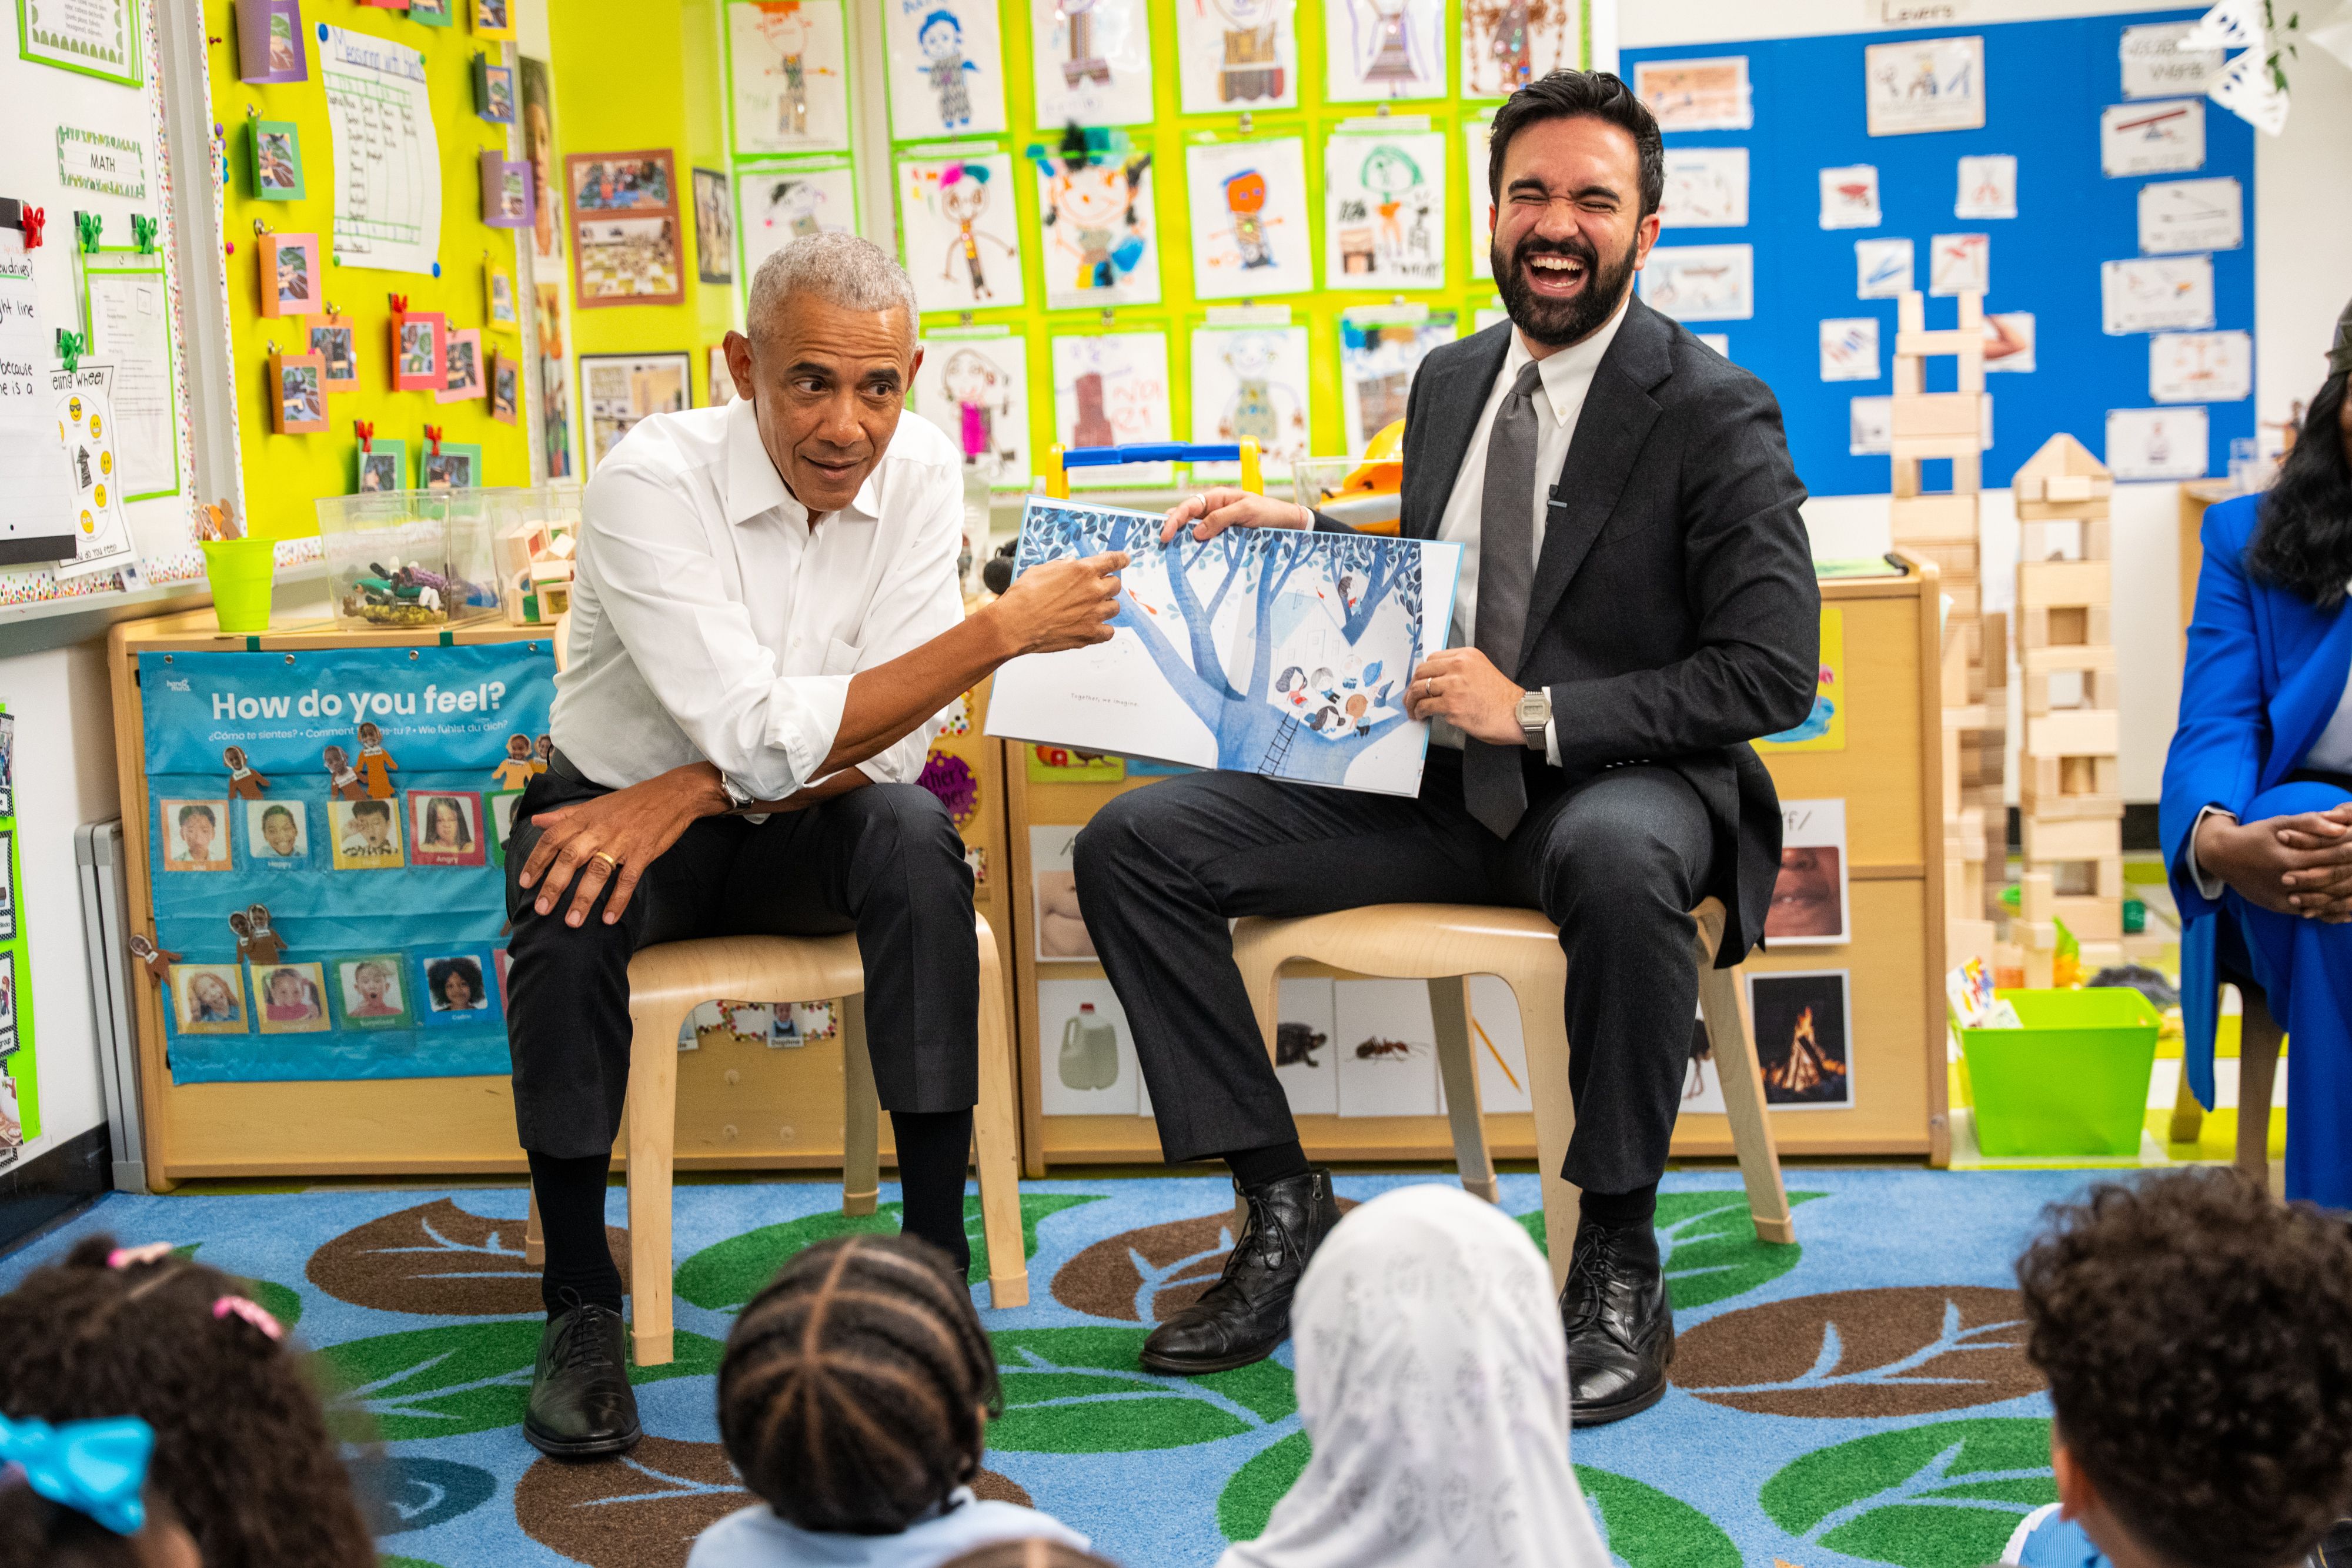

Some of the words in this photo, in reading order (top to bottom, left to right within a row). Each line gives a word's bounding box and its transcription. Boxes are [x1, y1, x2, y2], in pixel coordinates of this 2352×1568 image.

[91, 153, 115, 172] MATH
[17, 300, 34, 317] line
[0, 358, 33, 376] because
[12, 381, 21, 395] is
[26, 383, 33, 395] a
[212, 693, 290, 720] How
[298, 688, 342, 717] do
[348, 692, 416, 724] you
[424, 681, 506, 714] feel?
[1071, 693, 1100, 703] Together,
[1113, 698, 1139, 707] imagine.
[209, 731, 245, 741] ¿Cómo
[247, 731, 256, 740] te
[259, 729, 297, 738] sientes?
[306, 727, 355, 738] Comment
[419, 726, 436, 734] Wie
[467, 722, 480, 731] du
[483, 720, 508, 731] dich?
[436, 855, 459, 865] Angry
